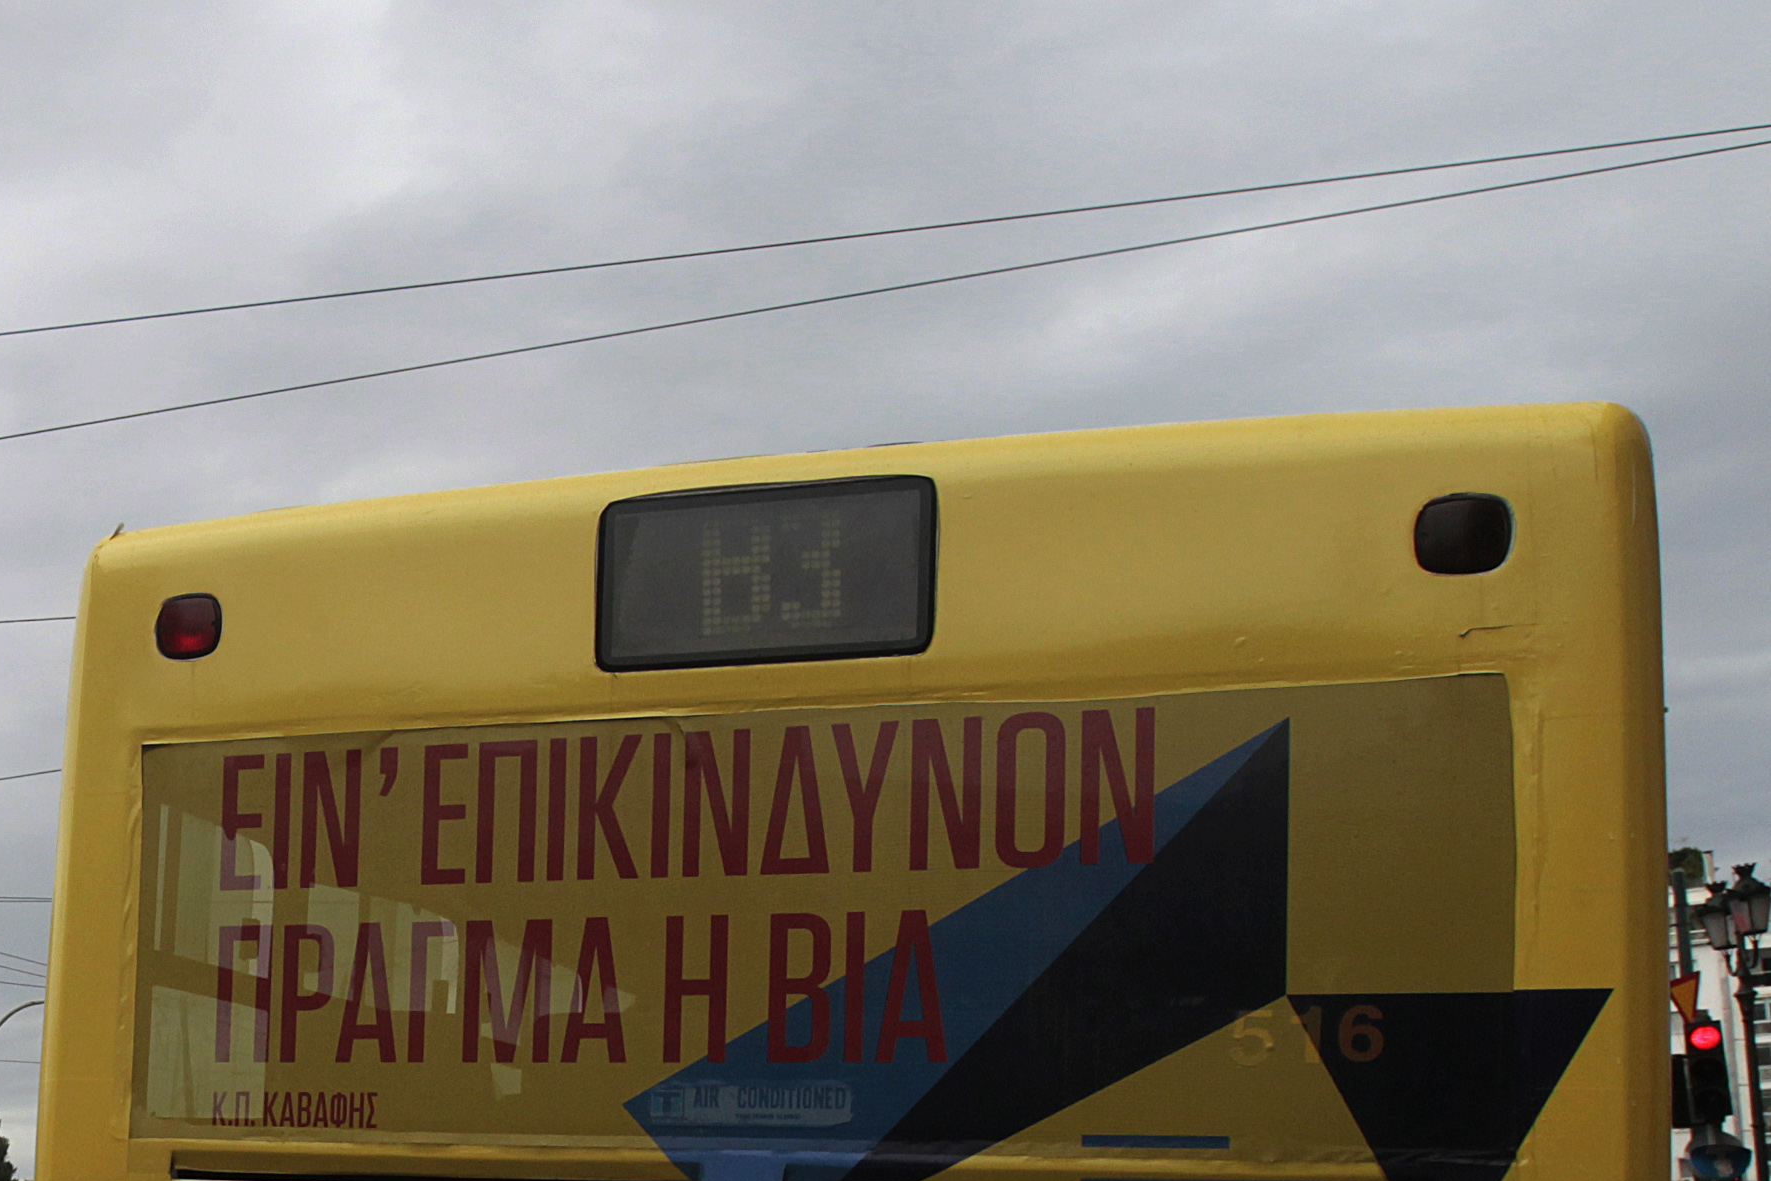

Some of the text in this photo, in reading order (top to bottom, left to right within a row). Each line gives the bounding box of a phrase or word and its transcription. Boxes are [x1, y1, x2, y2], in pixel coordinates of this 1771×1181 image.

[421, 706, 1156, 885] ΕΠΙΚΙΝΔΥΝΟΝ
[215, 909, 949, 1064] ΠΡΑΓΜΑ Η ΒΙΑ
[1230, 1005, 1385, 1067] 516
[212, 1091, 379, 1129] Κ.Π. ΚΑΒΑΦΗΣ
[692, 1086, 847, 1110] AIR CONDITIONED
